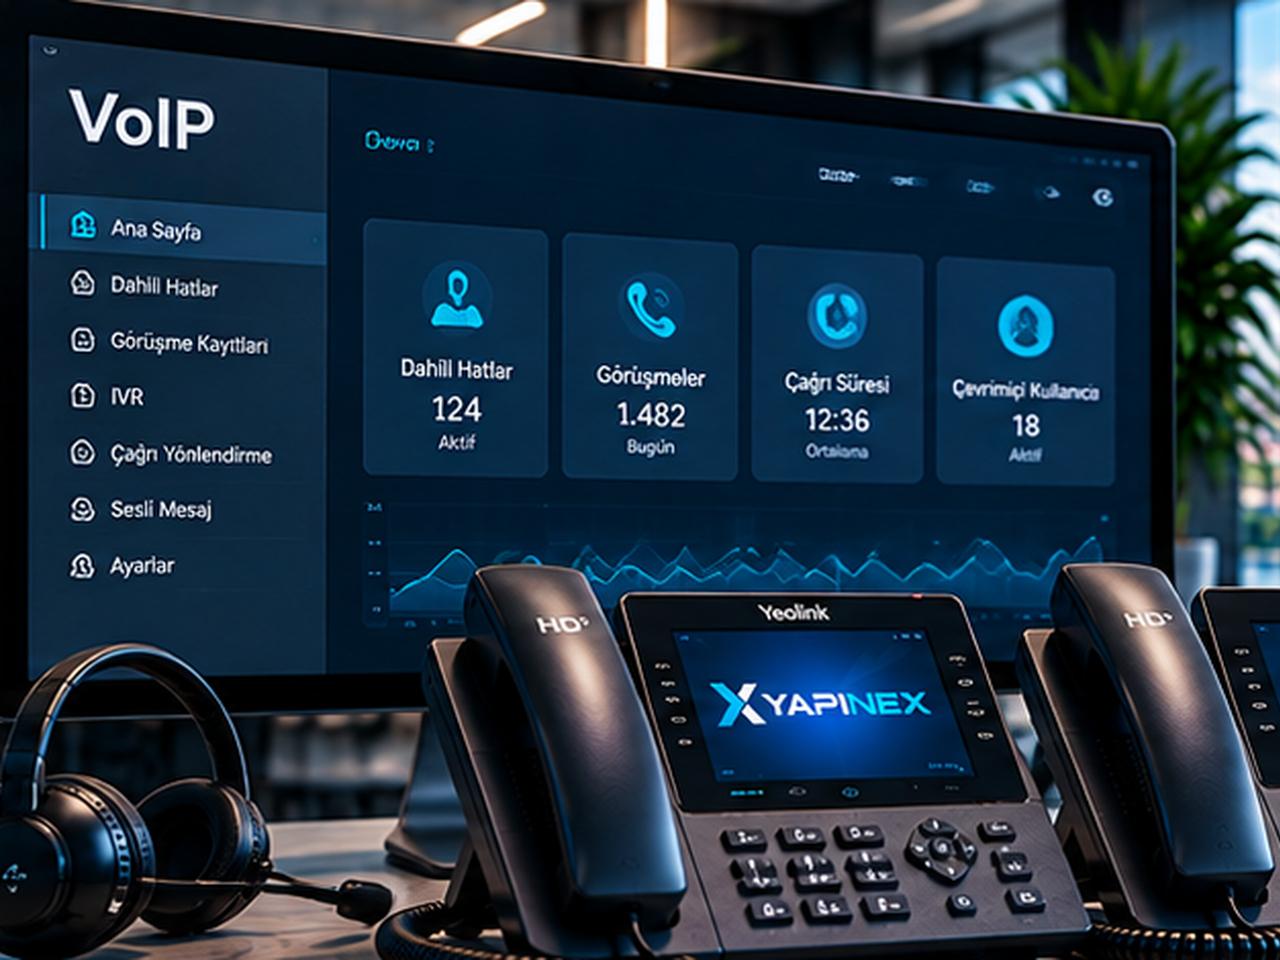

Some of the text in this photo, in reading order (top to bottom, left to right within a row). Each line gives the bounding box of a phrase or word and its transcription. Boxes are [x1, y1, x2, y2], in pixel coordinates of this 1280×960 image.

[69, 88, 215, 150] VoIP
[111, 219, 202, 244] Ana Sayfa
[166, 278, 219, 297] Hatlar
[111, 330, 193, 356] Görüşme
[457, 360, 514, 380] Hatlar
[785, 371, 890, 396] Çağrı Süresi
[111, 387, 144, 406] IVR
[432, 395, 483, 422] 124
[617, 402, 686, 428] 1.482
[805, 407, 870, 432] 12:36
[1012, 413, 1040, 437] 18
[438, 434, 476, 450] Aktif
[111, 443, 273, 467] Çağrı Yönlendirme
[111, 499, 212, 523] Sesli Mesaj
[110, 556, 175, 579] Ayarlar
[762, 691, 932, 717] YAPINEX
